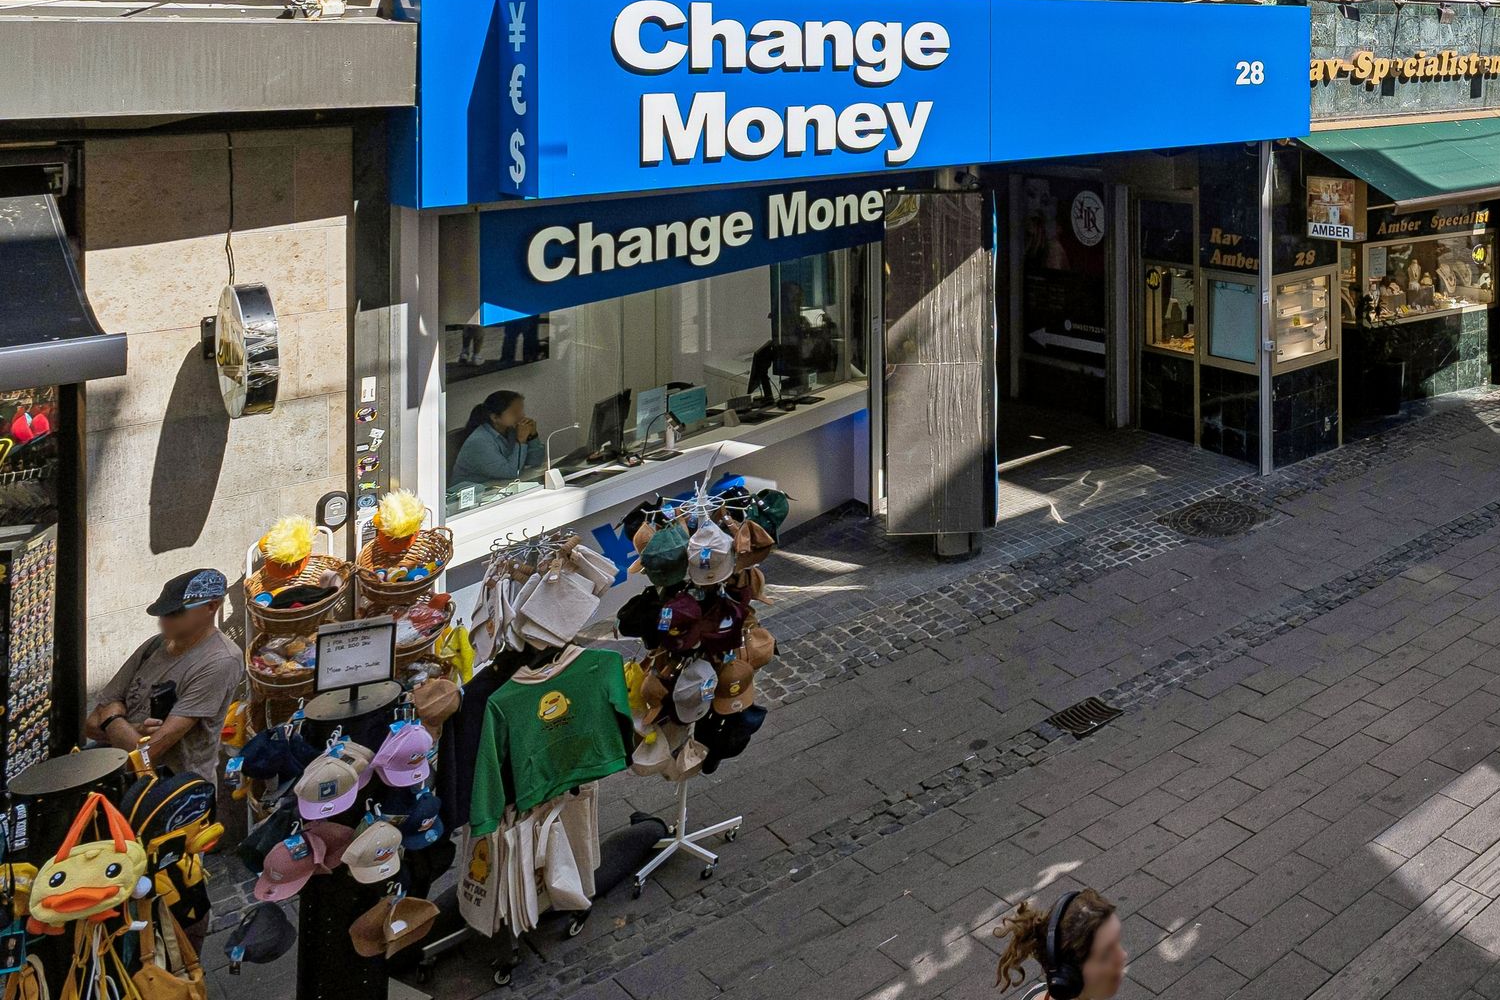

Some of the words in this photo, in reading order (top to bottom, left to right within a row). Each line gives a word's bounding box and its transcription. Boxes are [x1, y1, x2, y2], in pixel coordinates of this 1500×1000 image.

[612, 0, 951, 84] Change
[1235, 60, 1265, 86] 28
[641, 91, 934, 164] Money
[526, 209, 754, 283] Change
[768, 187, 906, 240] Mone
[1311, 224, 1350, 238] AMBER
[1376, 218, 1422, 235] Amber
[1430, 209, 1490, 229] Specialist
[1209, 227, 1243, 246] Rav
[1210, 249, 1260, 271] Amber
[1295, 250, 1316, 267] 28
